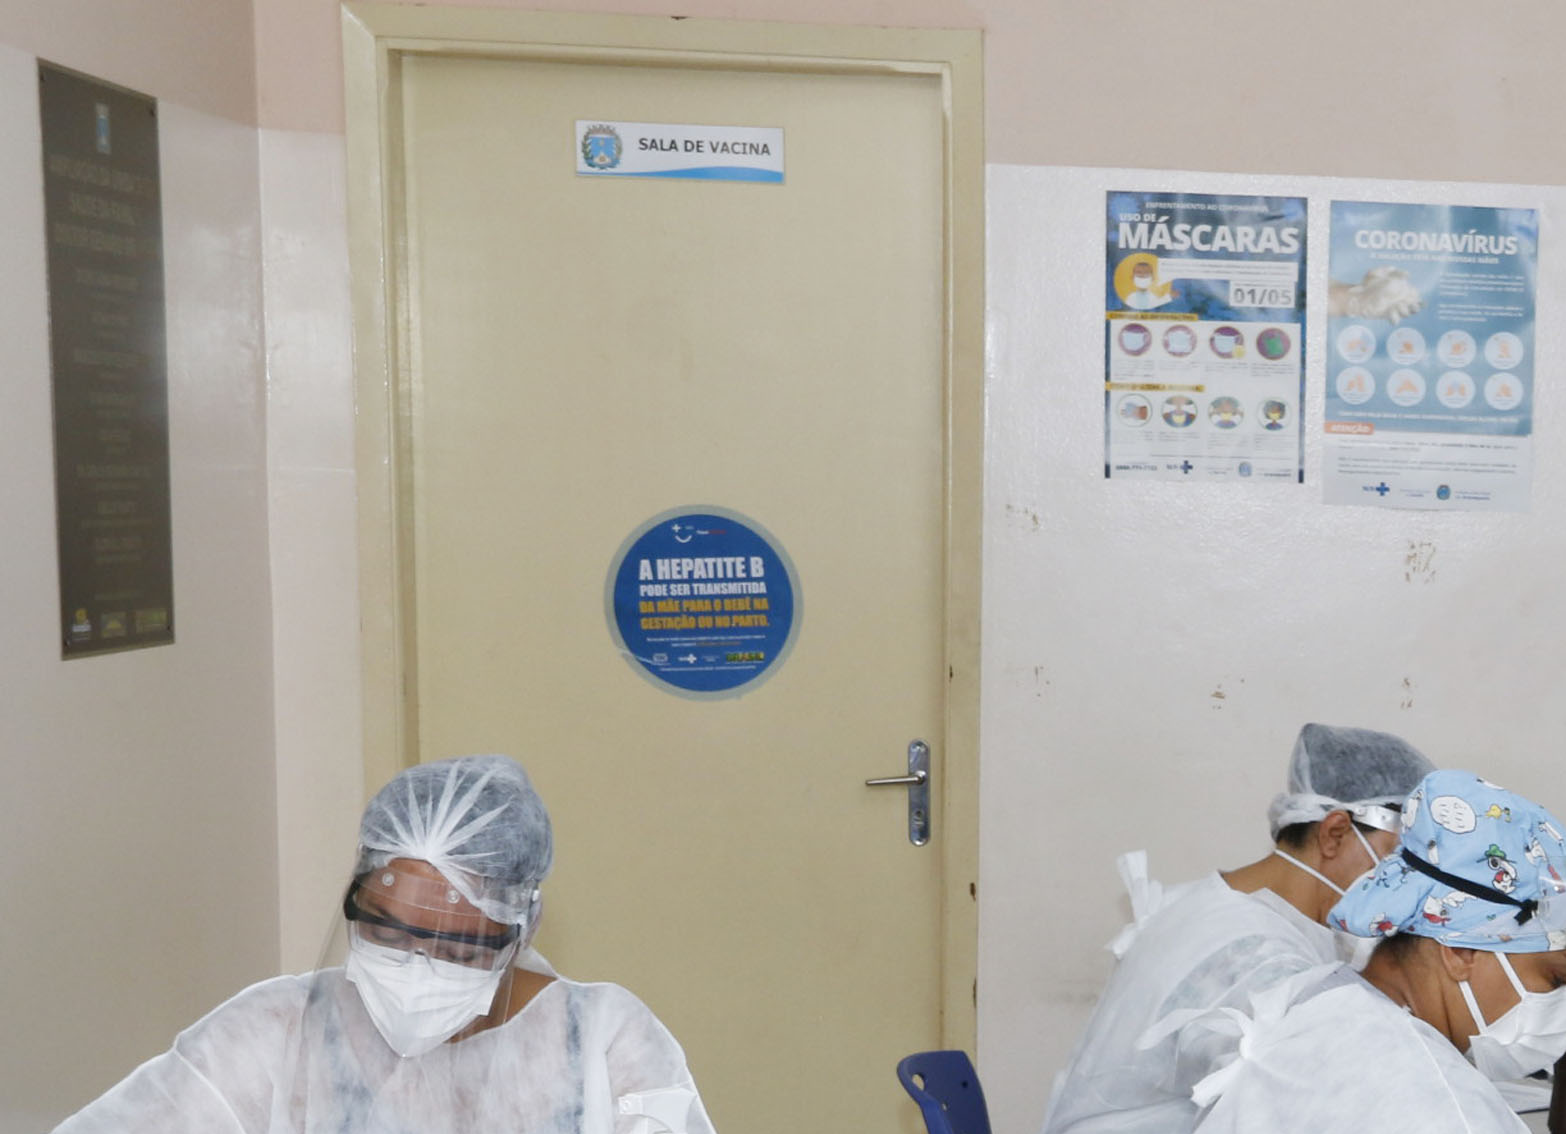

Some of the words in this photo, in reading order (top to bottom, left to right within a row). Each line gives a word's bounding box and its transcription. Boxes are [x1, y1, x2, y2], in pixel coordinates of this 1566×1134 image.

[638, 138, 678, 152] SALA
[684, 140, 704, 153] DE
[709, 141, 771, 155] VACINA
[1119, 213, 1140, 222] USO
[1143, 213, 1156, 223] DE
[1118, 216, 1299, 254] MÁSCARAS
[1355, 229, 1518, 255] CORONAVÍRUS
[1234, 288, 1292, 306] 01/05
[639, 559, 653, 580] A
[656, 557, 746, 580] HEPATITE
[751, 556, 764, 578] B
[640, 584, 668, 597] PODE
[670, 583, 691, 596] SER
[692, 582, 767, 595] TRANSMITIDA
[639, 601, 655, 613] DA
[657, 598, 680, 613] MÃE
[683, 599, 712, 612] PARA
[713, 599, 722, 611] O
[724, 597, 751, 611] BEBÊ
[753, 598, 769, 610] NA
[640, 615, 696, 630] GESTAÇÃO
[698, 616, 713, 628] OU
[715, 616, 730, 627] NO
